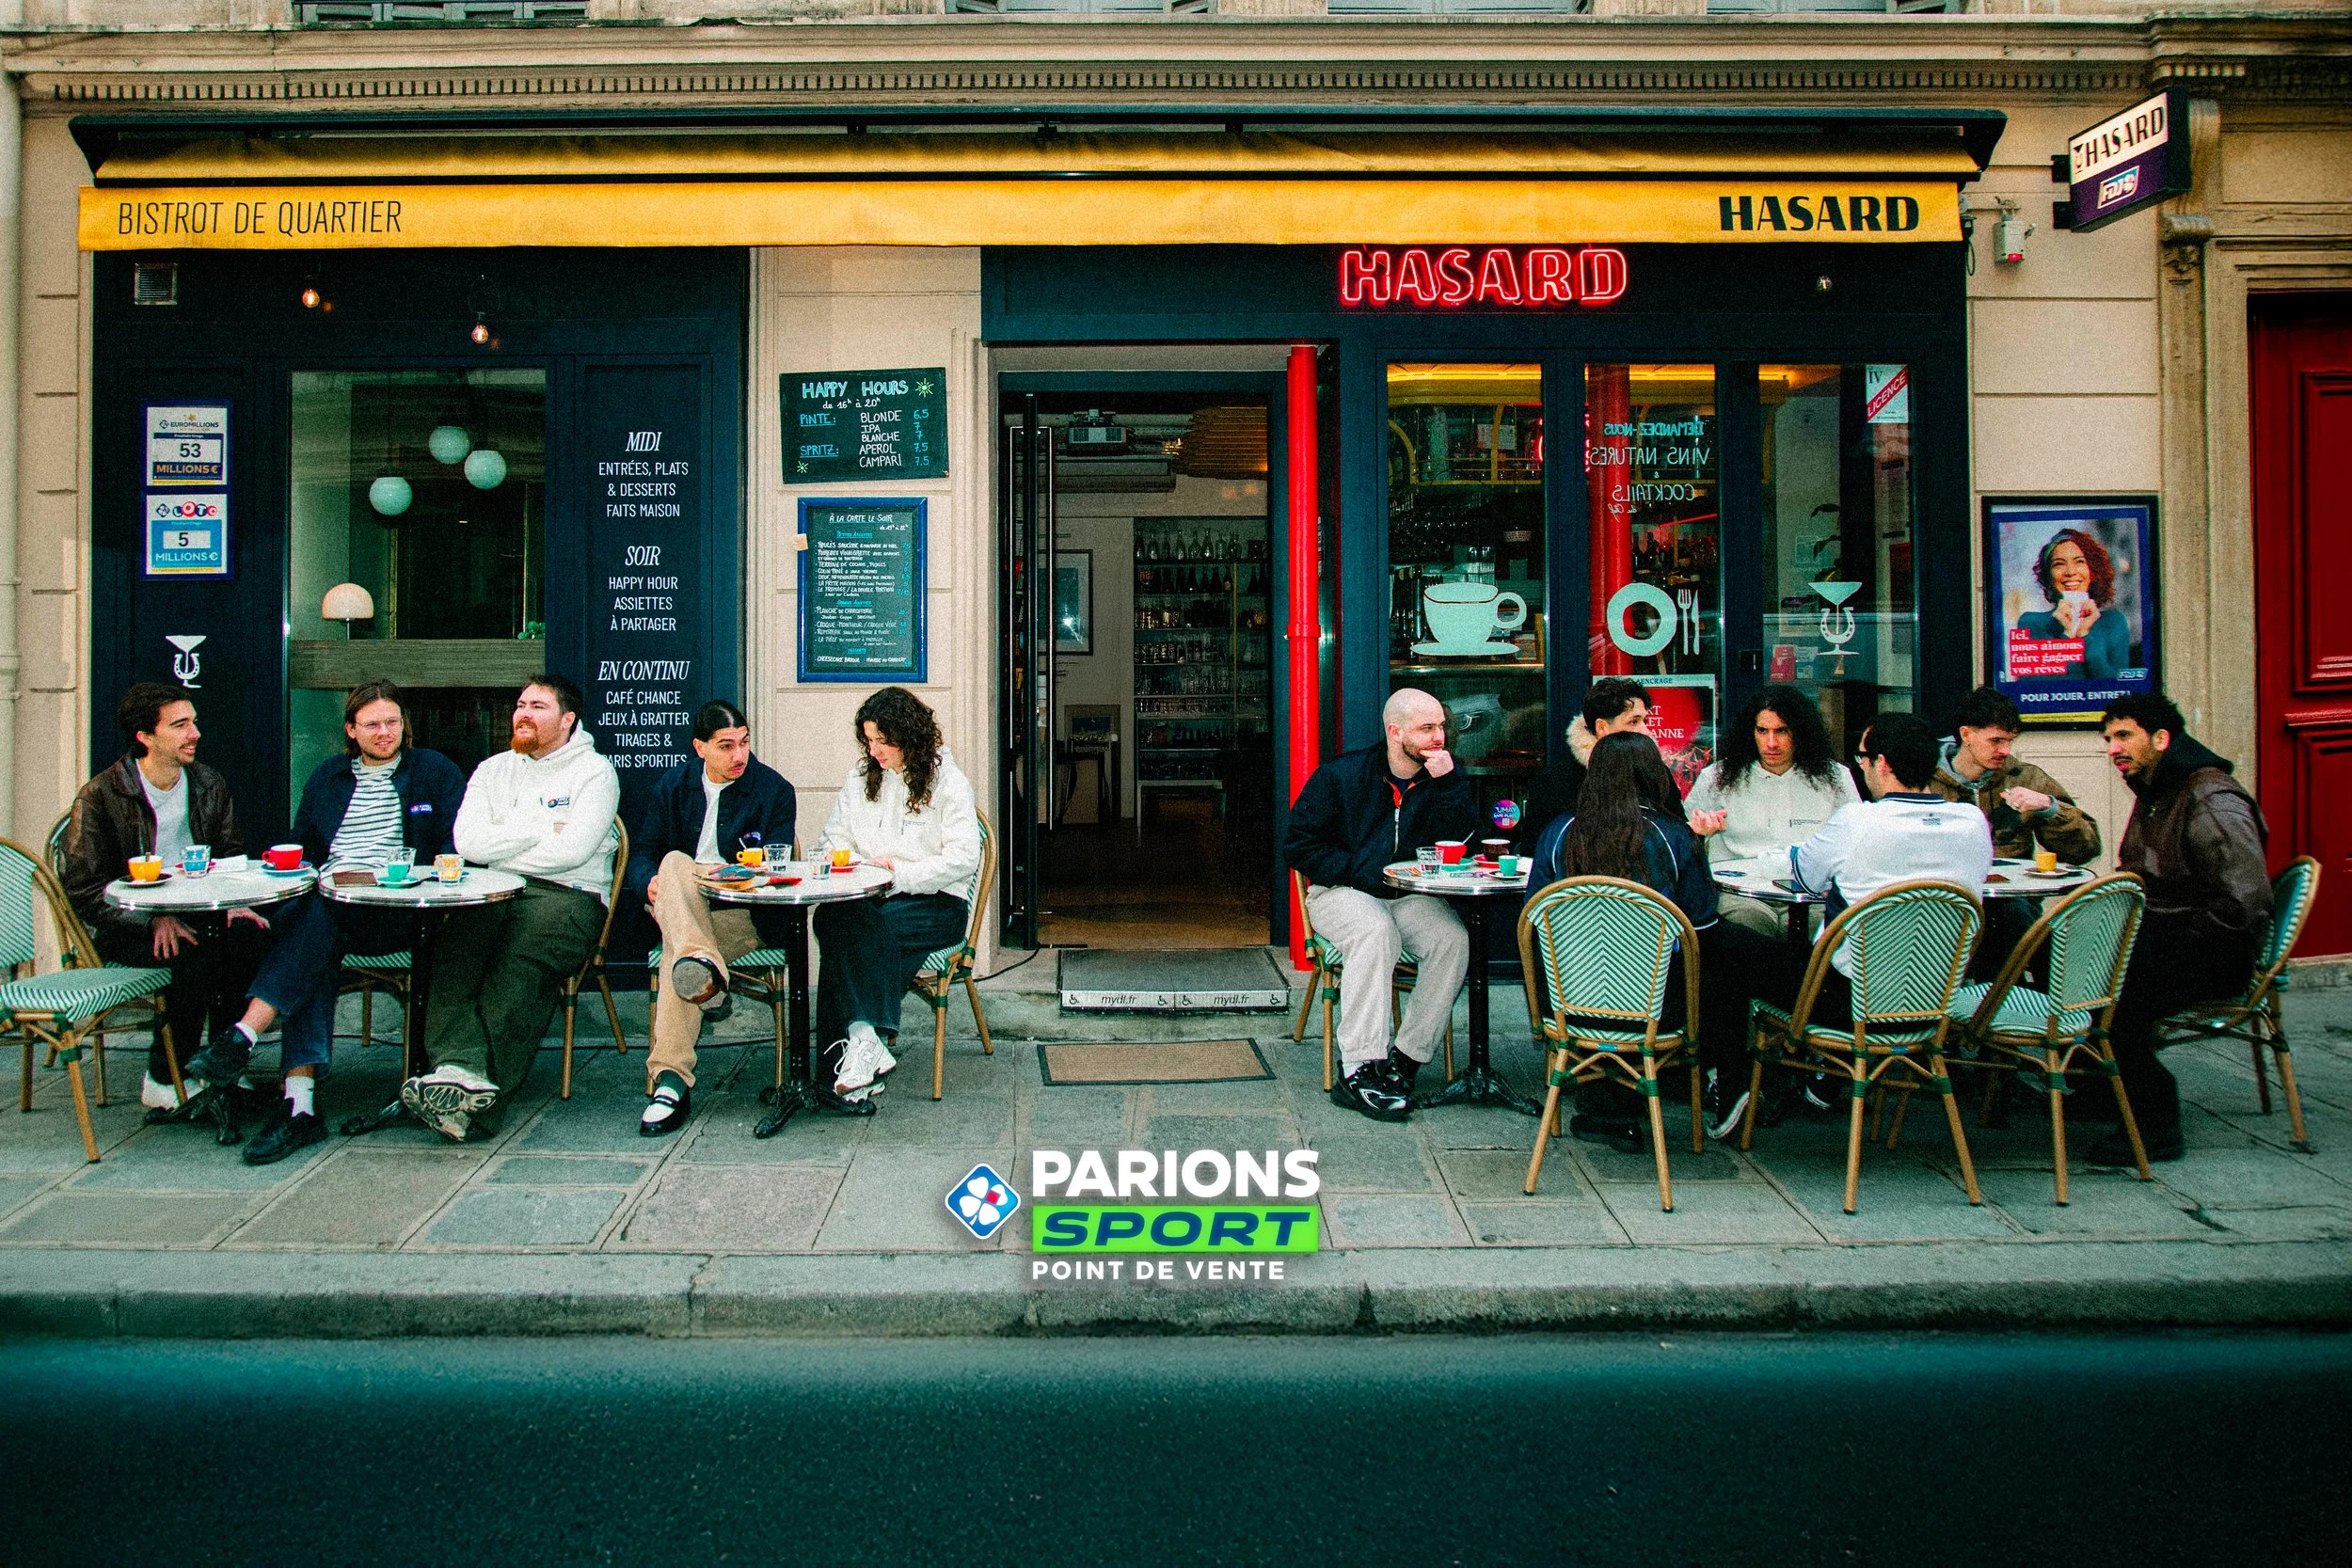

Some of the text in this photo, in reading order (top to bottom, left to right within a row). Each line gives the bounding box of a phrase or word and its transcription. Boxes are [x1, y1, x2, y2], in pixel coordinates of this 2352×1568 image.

[2085, 106, 2164, 167] HASARD
[118, 200, 402, 237] BISTROT DE QUARTIER
[1718, 195, 1920, 231] HASARD
[1342, 248, 1628, 304] HASARD
[1867, 371, 1883, 384] IV
[802, 379, 909, 399] HAPPY HOURS
[1867, 371, 1906, 417] LICENCE
[822, 401, 833, 409] de
[855, 399, 862, 408] à
[860, 409, 902, 423] BLONDE
[914, 408, 930, 420] 6.5
[860, 421, 921, 434] IPA 7
[625, 431, 662, 451] MIDI
[861, 431, 923, 443] BLANCHE 7
[180, 443, 202, 458] 53
[859, 443, 897, 455] APEROL
[914, 442, 929, 452] 7.5
[598, 460, 689, 477] ENTRÉES, PLATS
[914, 456, 930, 467] 7.5
[156, 464, 209, 474] MILLIONS
[607, 483, 676, 497] & DESSERTS
[173, 501, 217, 517] LOTO
[607, 503, 680, 517] FAITS MAISON
[847, 515, 866, 523] CARTE
[178, 531, 189, 547] 5
[155, 552, 207, 562] MILLIONS
[625, 546, 661, 566] SOIR
[609, 576, 678, 590] HAPPY HOUR
[613, 596, 673, 610] ASSIETTES
[610, 614, 676, 631] À PARTAGER
[2010, 641, 2084, 651] nous aimons
[2010, 653, 2083, 663] faire gagner
[597, 660, 691, 681] EN CONTINU
[2011, 664, 2067, 674] vos rêves
[606, 689, 681, 705] CAFÉ CHANCE
[2021, 692, 2049, 702] POUR
[2051, 691, 2086, 702] JOUER,
[598, 709, 690, 726] JEUX À GRATTER
[614, 733, 673, 747] TIRAGES &
[602, 754, 631, 768] ARIS
